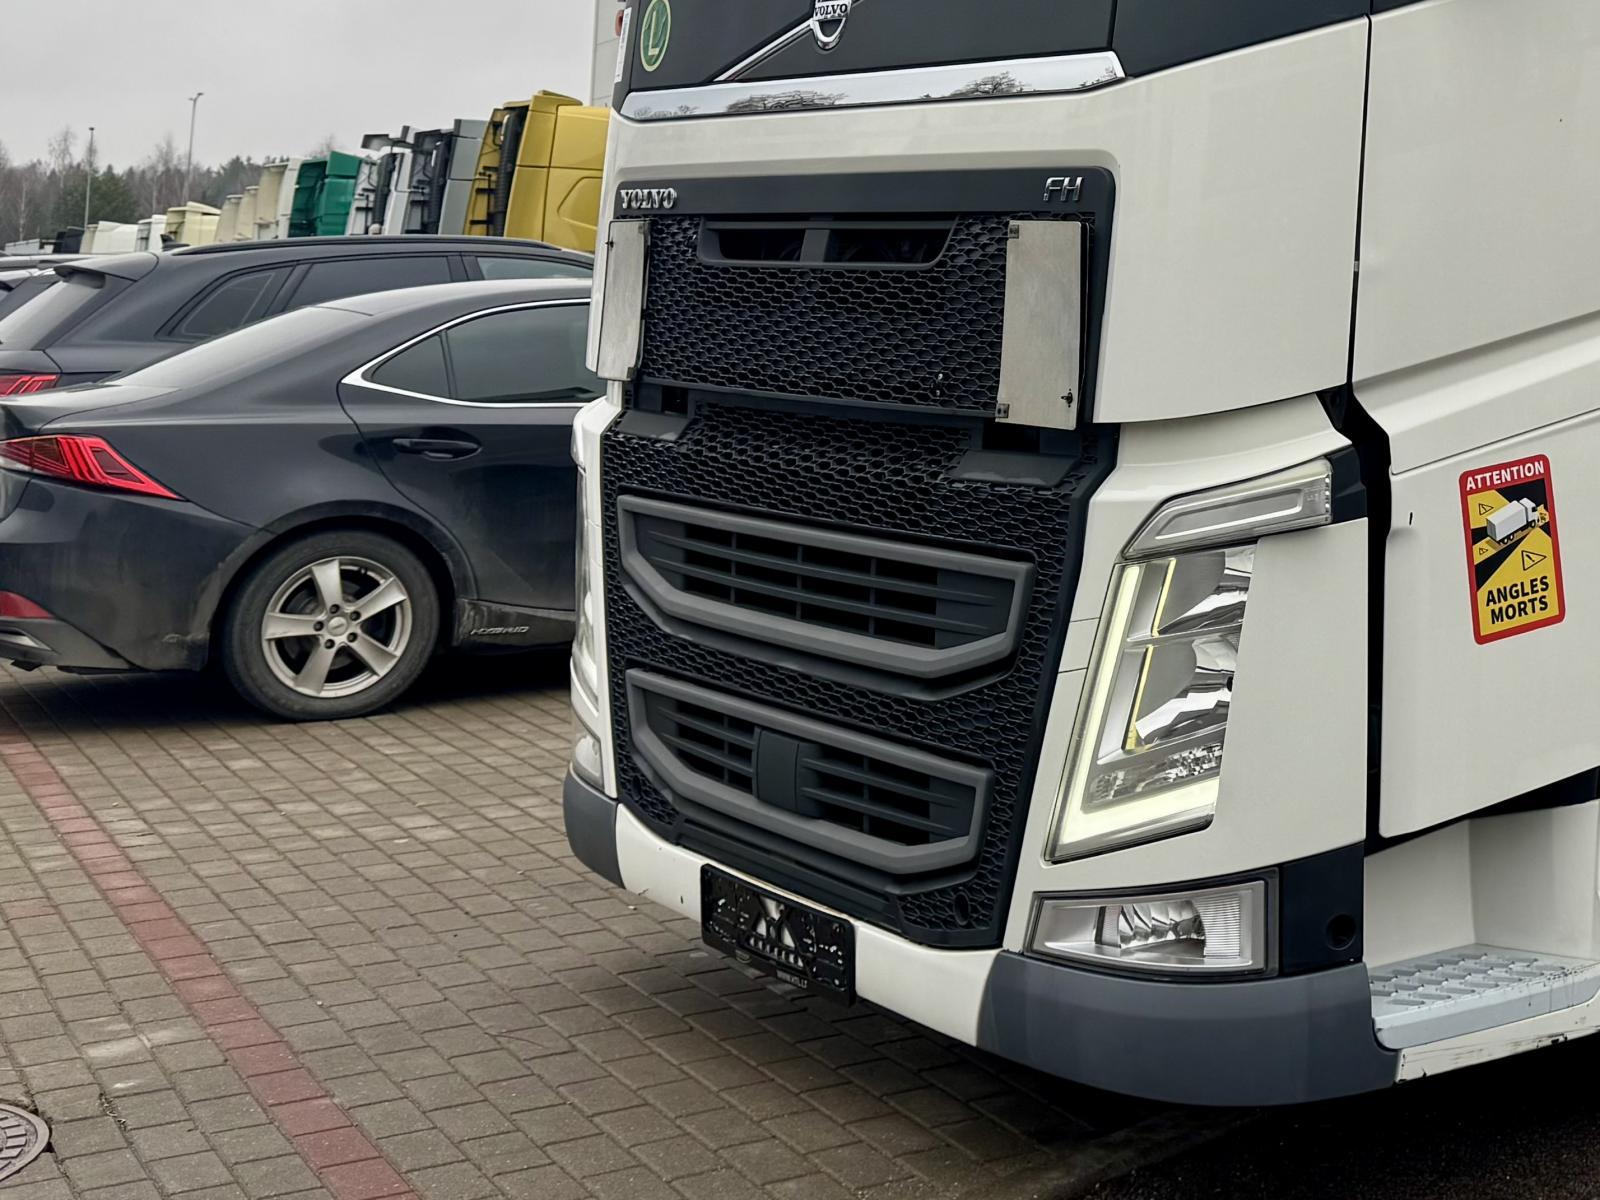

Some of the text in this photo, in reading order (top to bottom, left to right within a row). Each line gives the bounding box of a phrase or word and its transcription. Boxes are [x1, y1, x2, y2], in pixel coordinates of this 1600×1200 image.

[813, 2, 849, 19] VOLVO
[648, 10, 661, 56] L
[619, 187, 678, 210] VOLVO
[1043, 176, 1084, 202] FH
[1465, 460, 1545, 492] ATTENTION
[1485, 575, 1550, 607] ANGLES
[1490, 594, 1549, 625] MORTS
